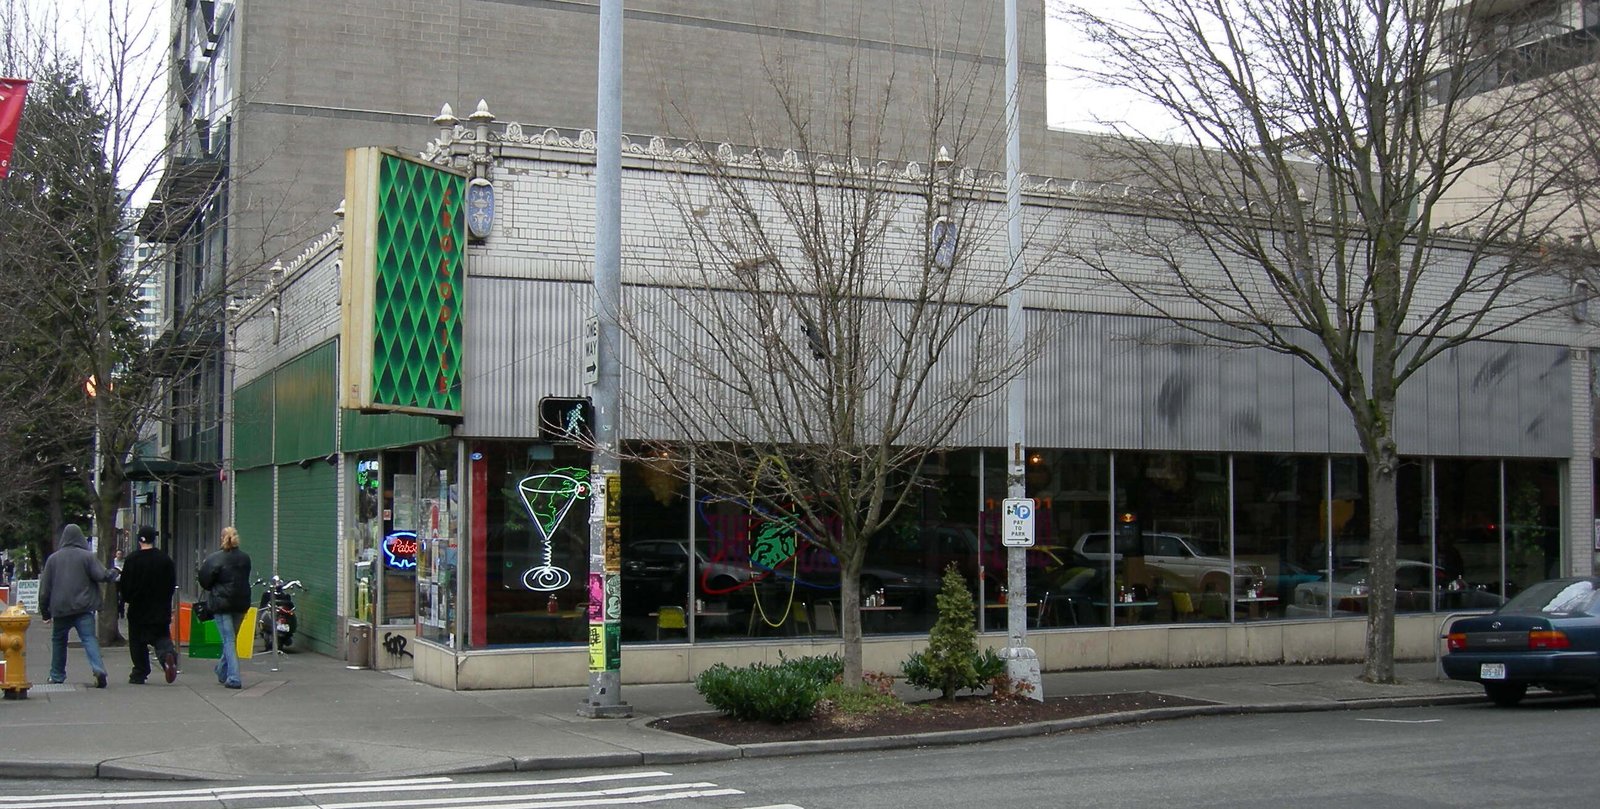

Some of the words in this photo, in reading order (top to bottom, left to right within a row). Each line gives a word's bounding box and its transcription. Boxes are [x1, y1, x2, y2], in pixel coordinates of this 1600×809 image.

[120, 208, 145, 217] 33-8
[438, 189, 453, 394] CROCODILE
[586, 321, 597, 339] ONE
[585, 340, 597, 357] WAY
